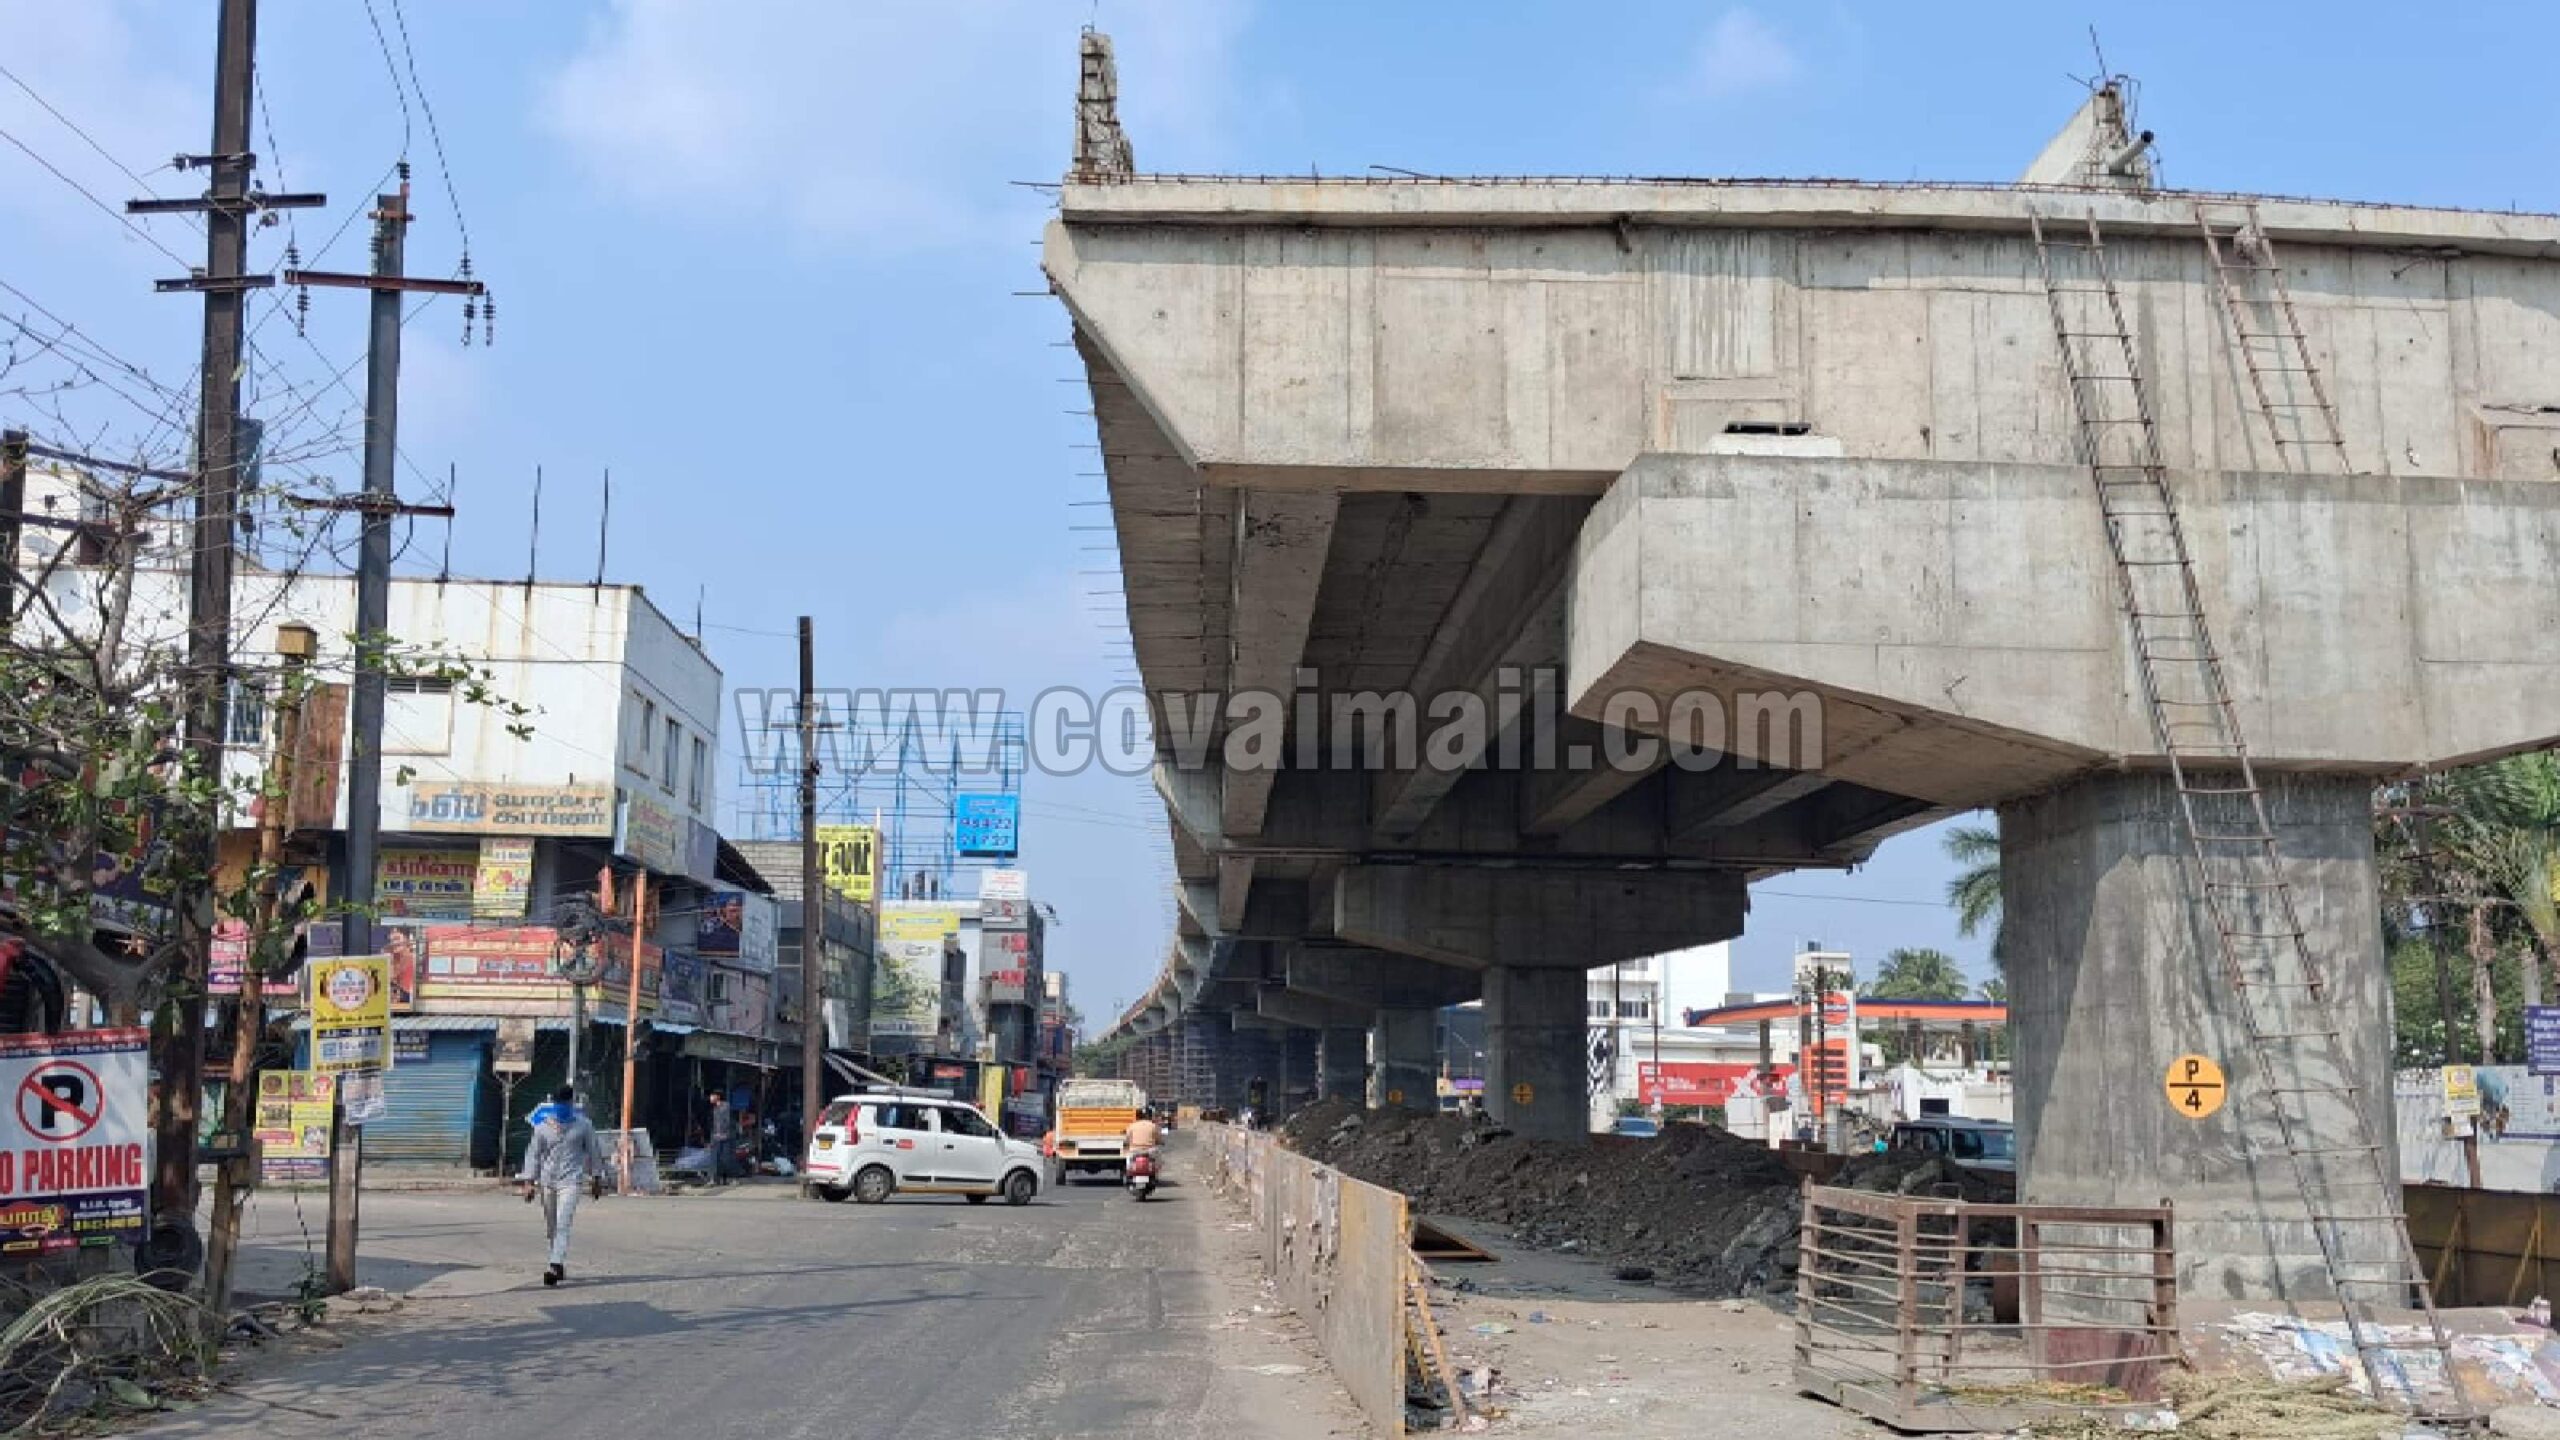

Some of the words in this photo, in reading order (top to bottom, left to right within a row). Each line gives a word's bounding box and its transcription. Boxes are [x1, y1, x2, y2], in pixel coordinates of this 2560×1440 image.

[2185, 1060, 2199, 1081] P
[41, 1074, 83, 1129] P
[2185, 1089, 2202, 1111] 4
[0, 1151, 13, 1194] O
[23, 1143, 142, 1193] PARKING
